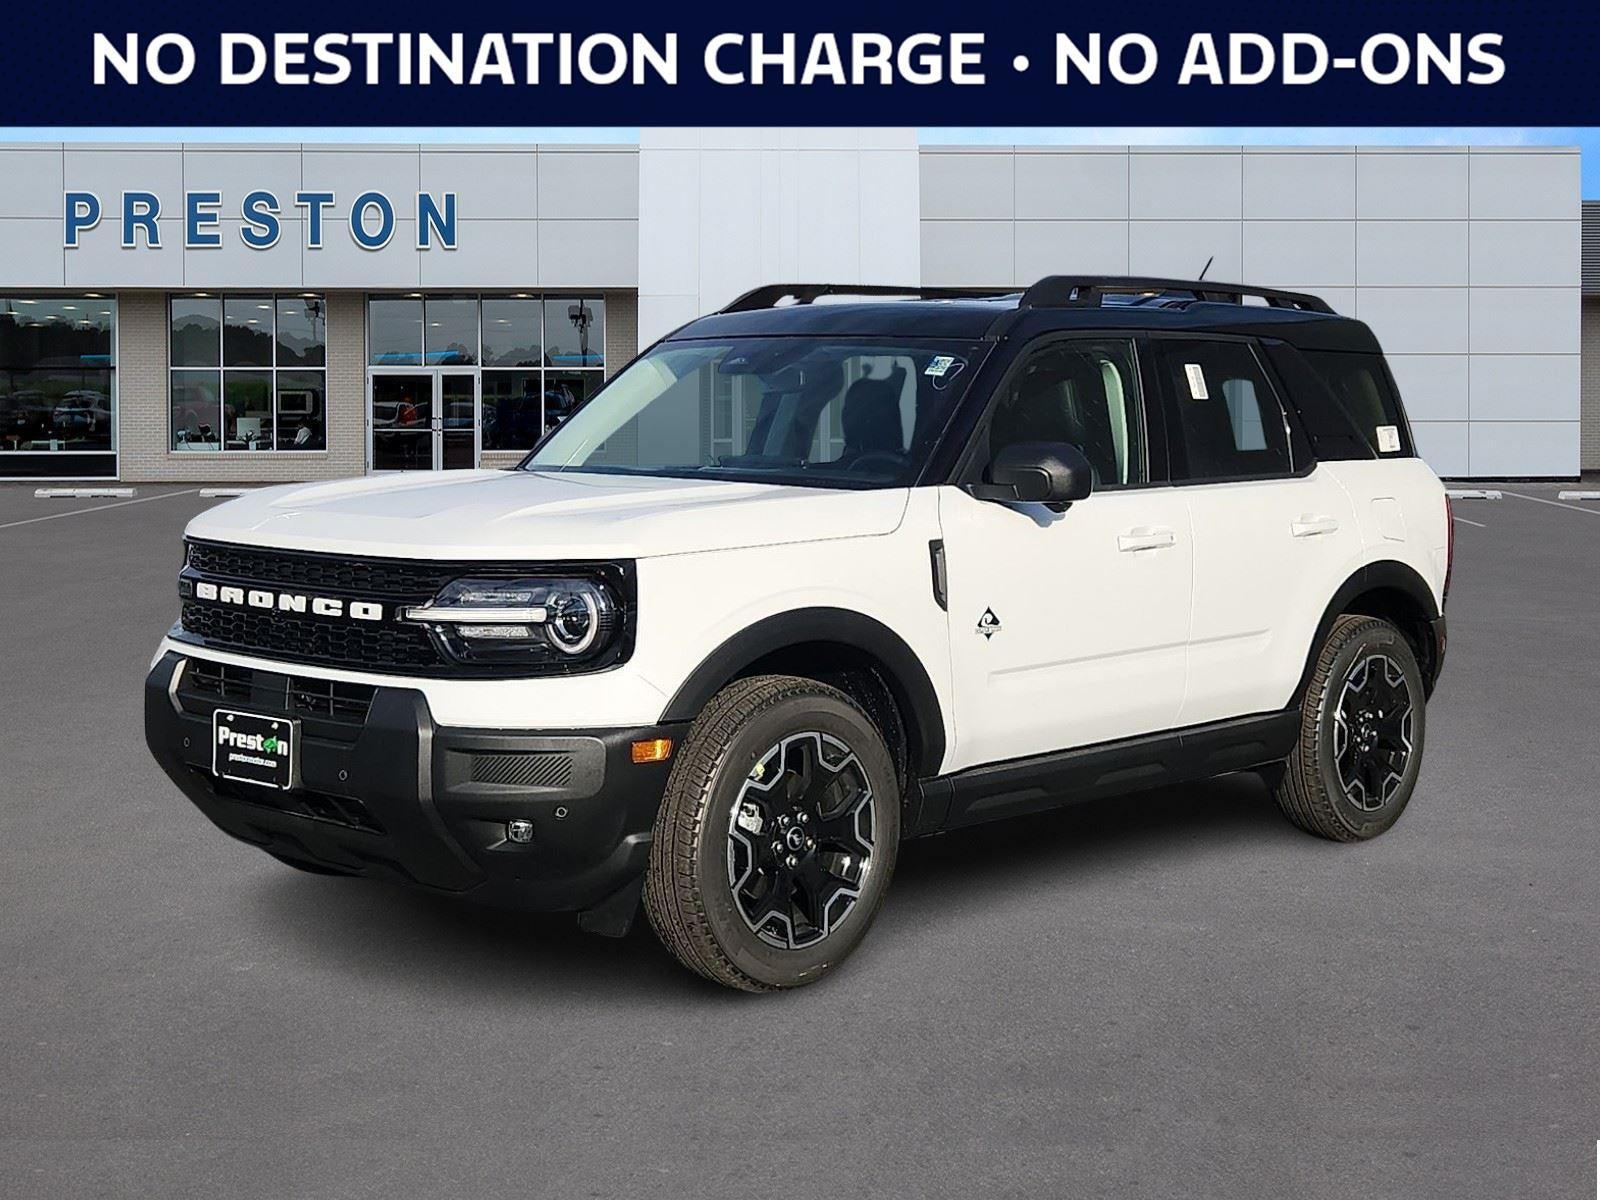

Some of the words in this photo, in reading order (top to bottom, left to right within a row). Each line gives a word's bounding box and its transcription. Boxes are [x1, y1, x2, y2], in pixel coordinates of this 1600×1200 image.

[63, 190, 458, 250] PRESTON
[196, 582, 383, 621] BRONCO
[218, 726, 288, 756] Preston
